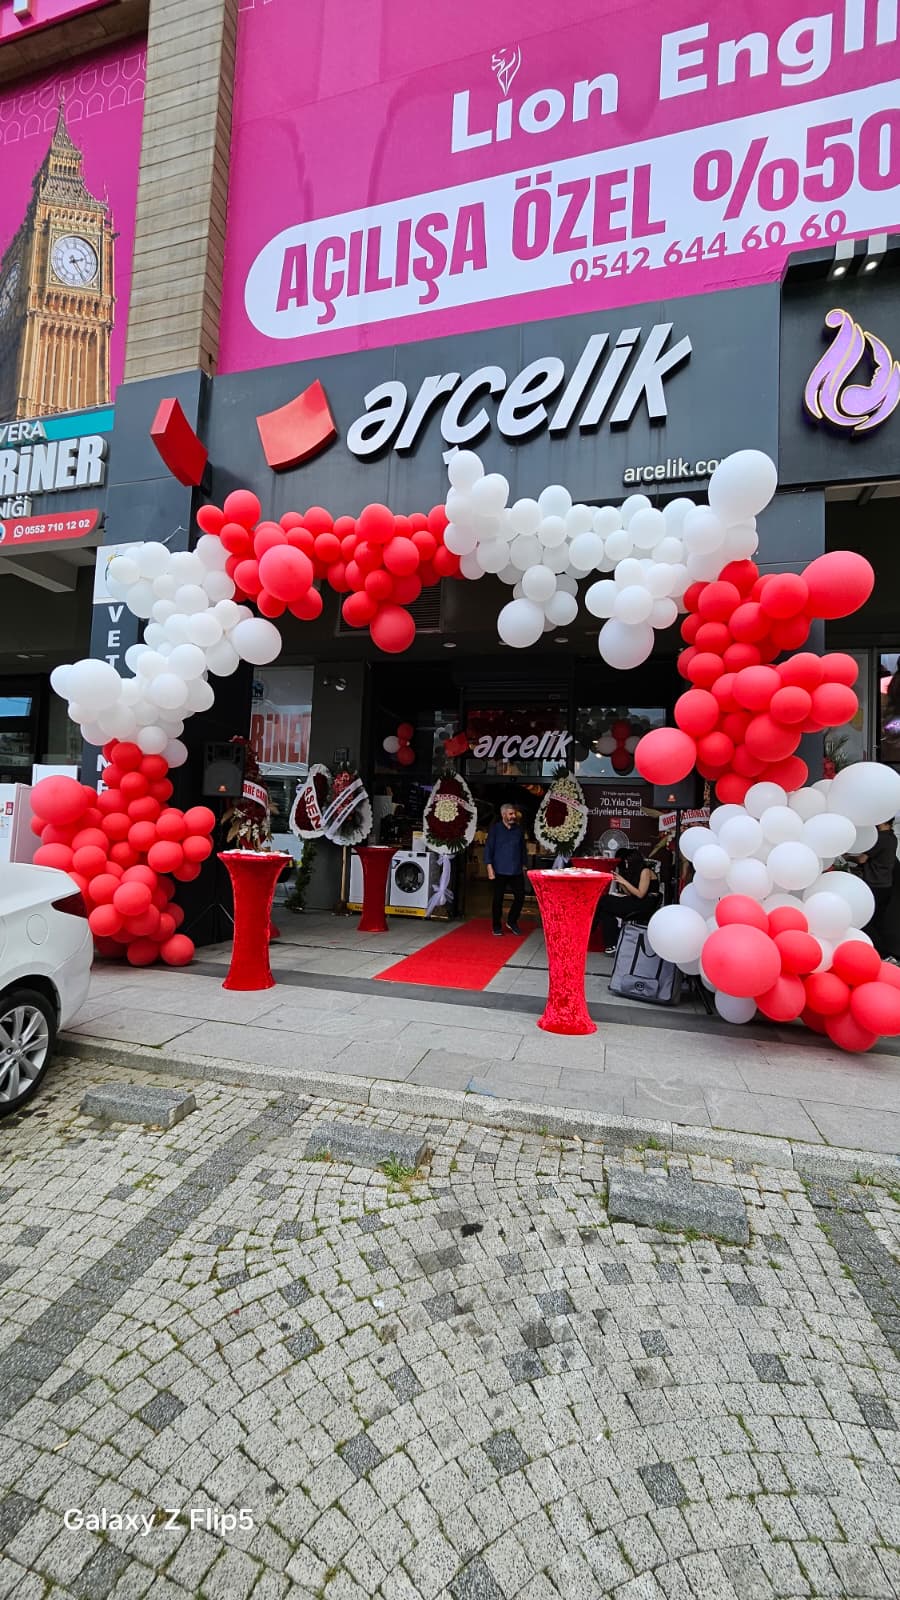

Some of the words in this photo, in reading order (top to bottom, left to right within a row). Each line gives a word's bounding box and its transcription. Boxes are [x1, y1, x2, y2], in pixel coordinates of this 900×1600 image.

[451, 73, 618, 154] Lion
[276, 202, 487, 325] AÇILIŞA
[512, 164, 666, 260] ÖZEL
[570, 247, 650, 283] 0542
[663, 232, 728, 266] 644
[742, 221, 786, 250] 60
[801, 210, 847, 240] 60
[624, 458, 722, 482] arcelik.co
[25, 525, 46, 535] 0552
[48, 522, 63, 532] 710
[66, 521, 76, 530] 12
[79, 519, 90, 528] 02
[473, 731, 572, 763] arçelik
[305, 786, 321, 829] ASEN
